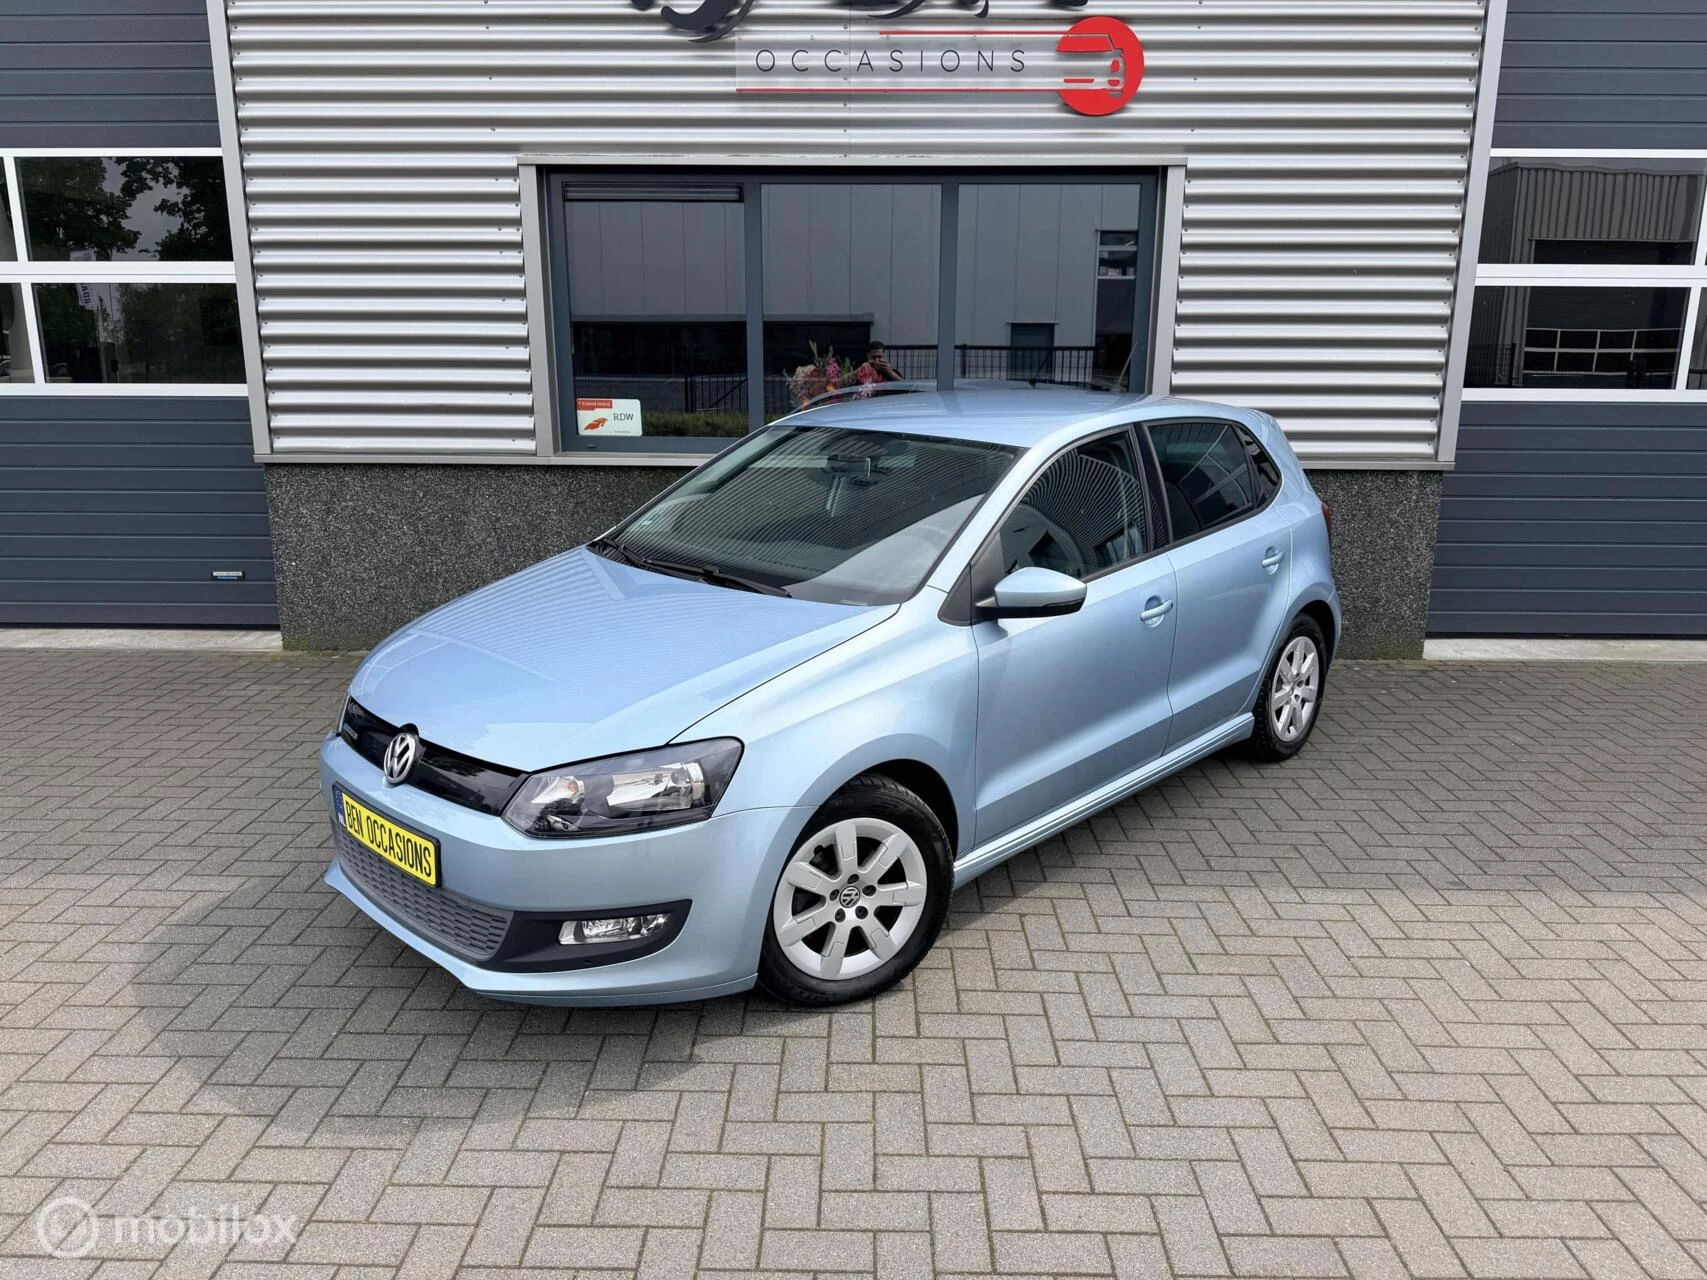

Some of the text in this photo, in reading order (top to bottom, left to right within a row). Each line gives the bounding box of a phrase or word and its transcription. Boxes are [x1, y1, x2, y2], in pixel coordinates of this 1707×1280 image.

[756, 49, 1026, 73] OCCASIONS
[613, 413, 634, 421] RDW
[345, 800, 432, 877] BEN OCCASIONS
